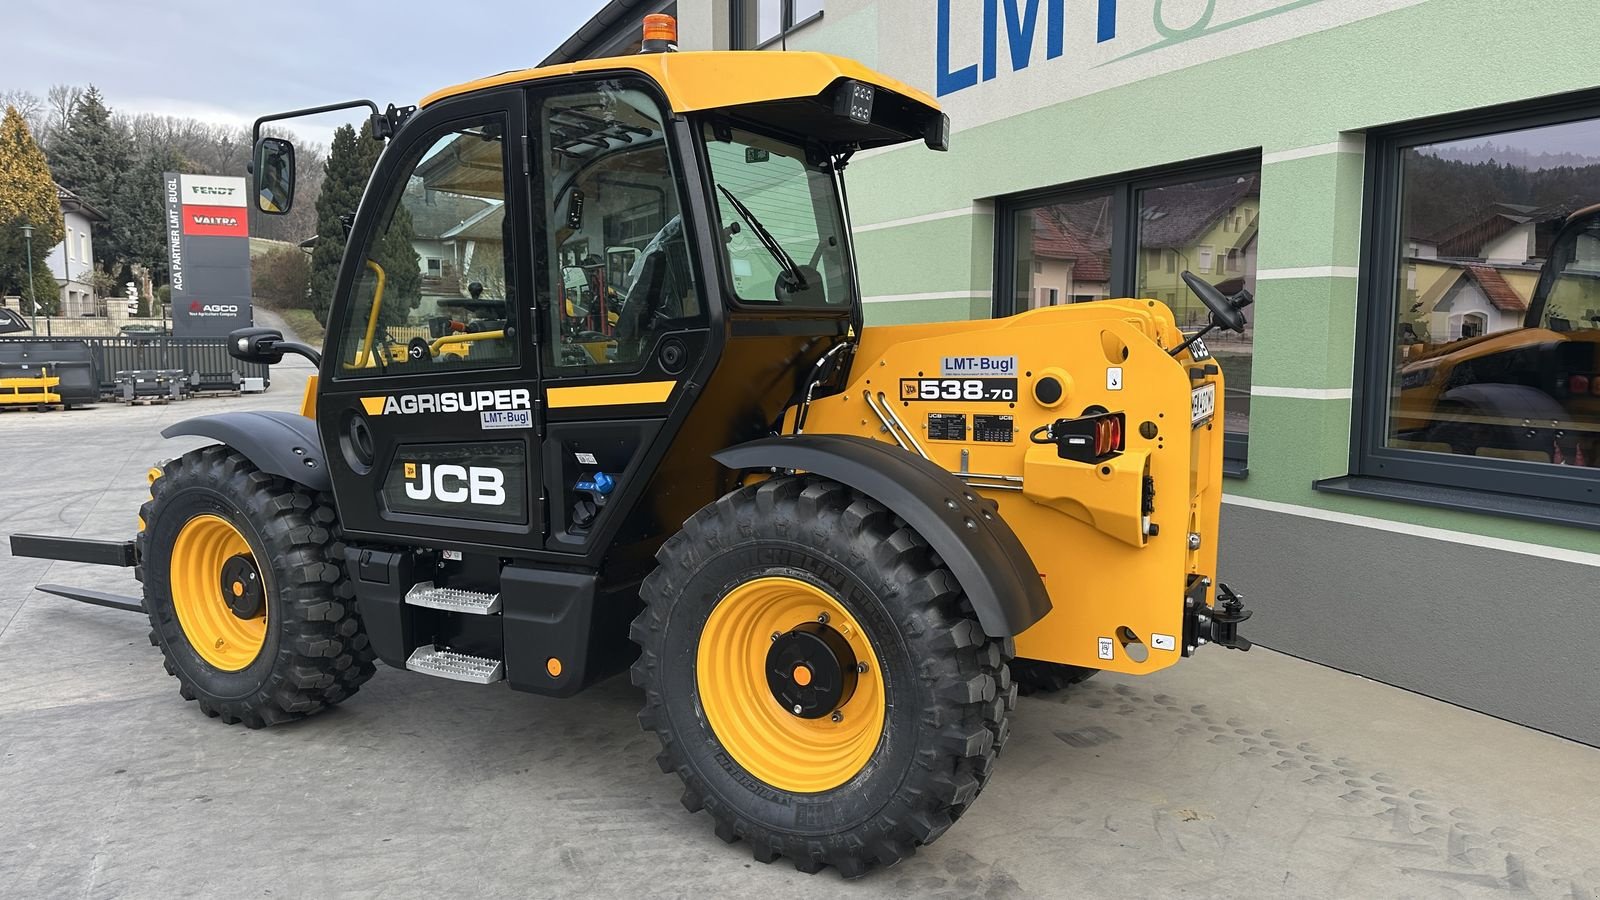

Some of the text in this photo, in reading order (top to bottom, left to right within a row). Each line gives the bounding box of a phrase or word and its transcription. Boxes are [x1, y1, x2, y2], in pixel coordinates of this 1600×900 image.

[936, 0, 1116, 98] LM
[167, 178, 178, 203] BUGL
[192, 186, 236, 196] FENDT
[169, 209, 179, 229] LMT
[193, 215, 239, 226] VALTRA
[171, 230, 181, 270] PARTNER
[173, 272, 183, 290] ACA
[203, 304, 238, 312] AGCO
[945, 357, 1014, 373] LMT-Bugl
[383, 388, 531, 415] AGRISUPER
[483, 411, 529, 425] LMT-Bugl
[404, 463, 506, 506] JCB
